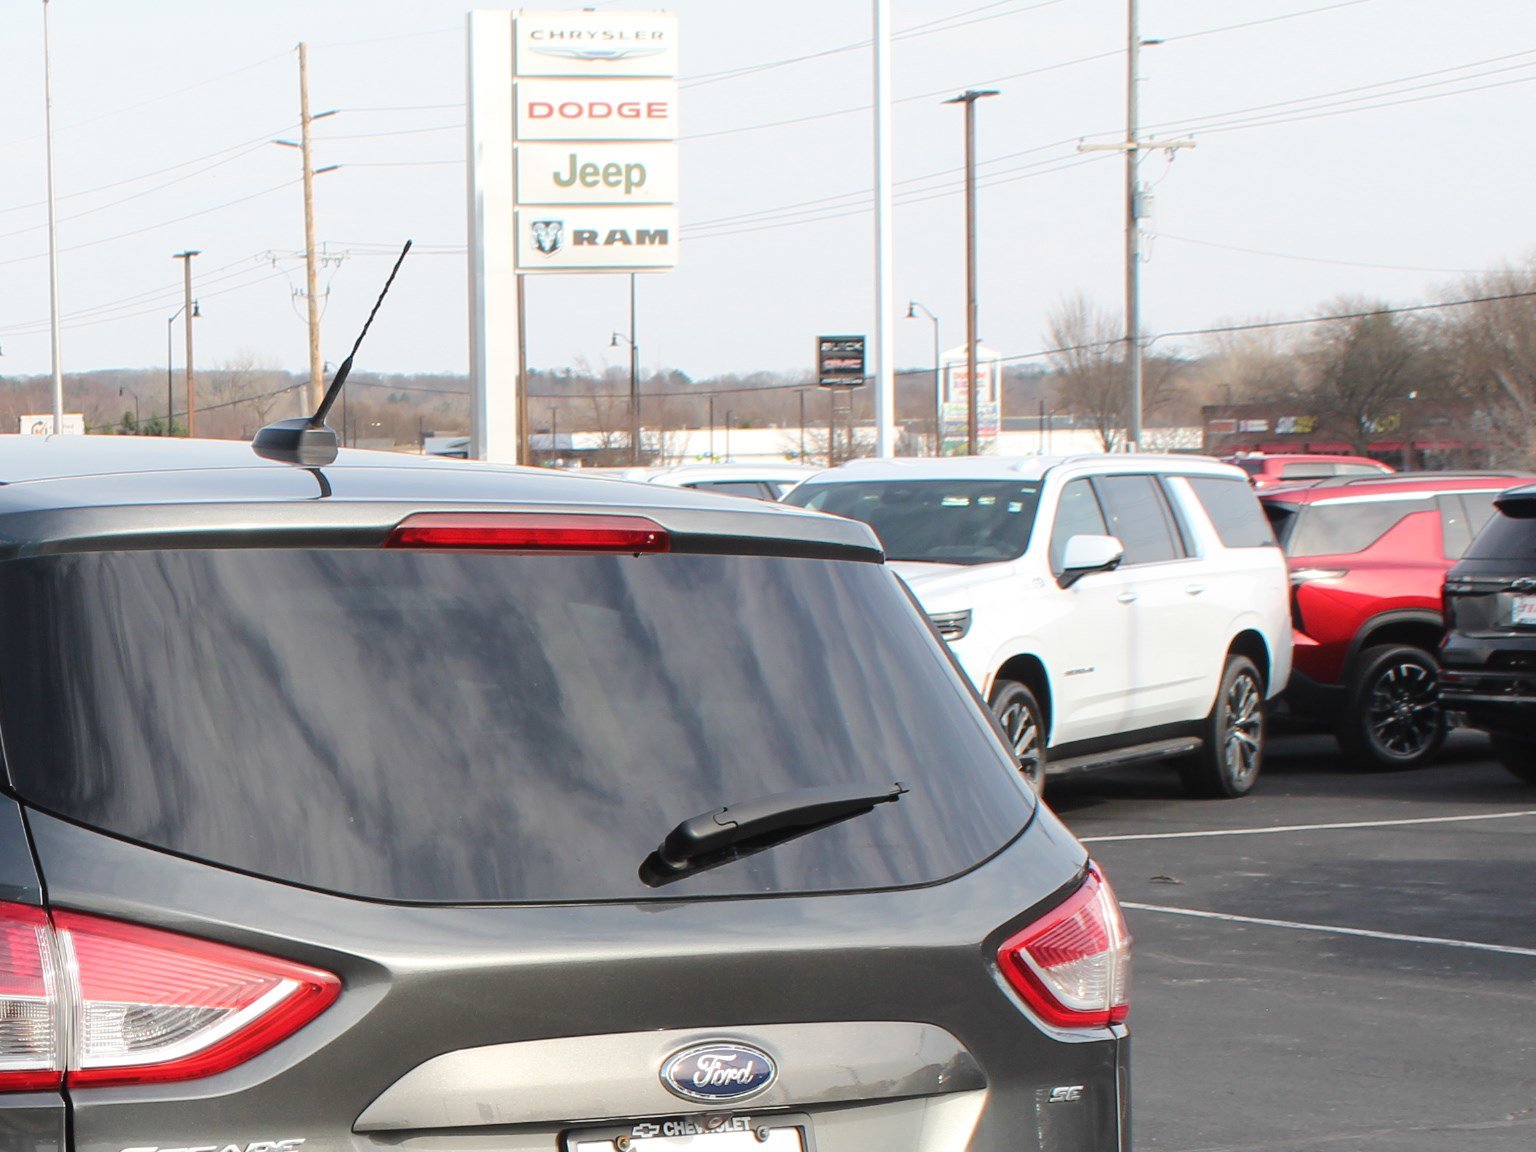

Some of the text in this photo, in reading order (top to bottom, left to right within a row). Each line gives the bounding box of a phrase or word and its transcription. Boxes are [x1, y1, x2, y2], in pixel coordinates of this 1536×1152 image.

[529, 30, 665, 41] CHRYSLER
[527, 101, 669, 119] DODGE
[552, 153, 647, 195] Jeep
[572, 229, 670, 246] RAM
[692, 1053, 755, 1088] Ford
[1048, 1085, 1084, 1103] SE
[663, 1116, 751, 1136] CHEVLET
